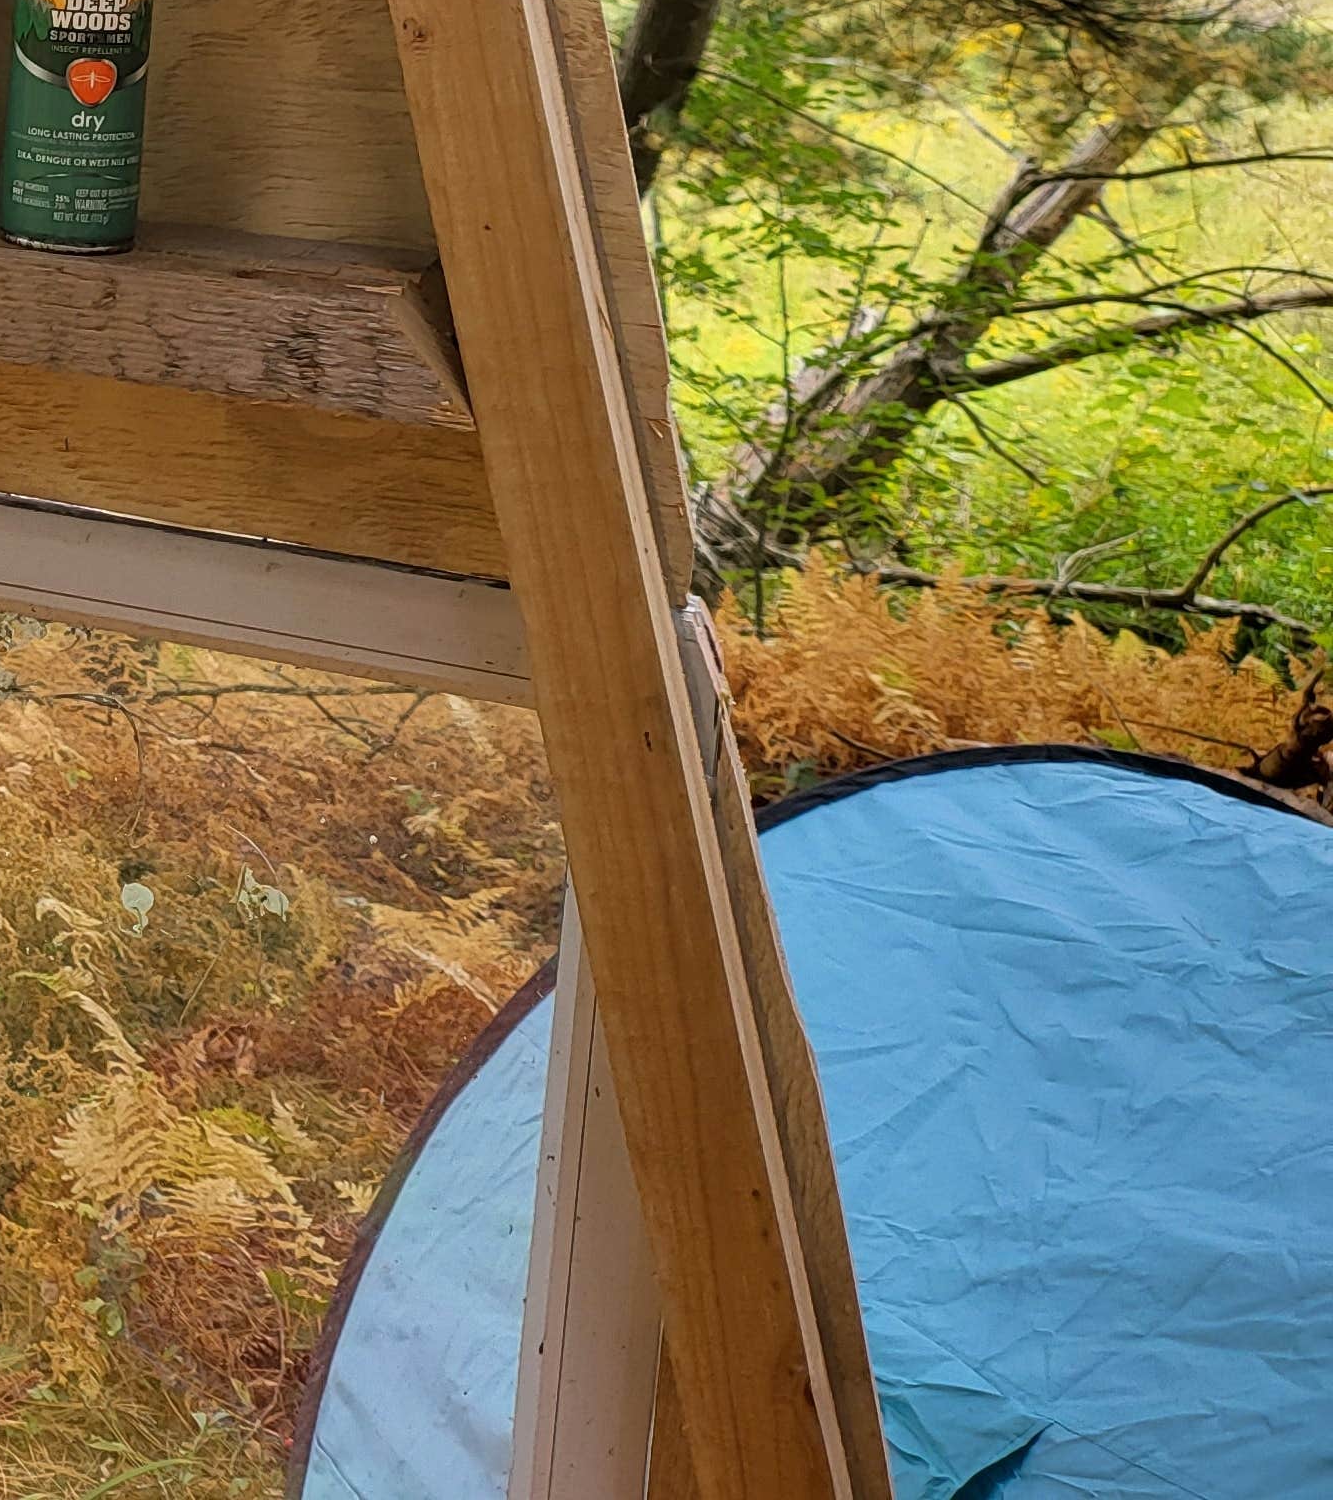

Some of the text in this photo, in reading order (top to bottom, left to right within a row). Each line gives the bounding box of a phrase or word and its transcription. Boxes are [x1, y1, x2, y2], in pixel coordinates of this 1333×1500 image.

[50, 9, 132, 31] WOODS
[49, 29, 132, 45] SPORTMEN
[52, 45, 80, 54] INSECT
[71, 111, 105, 132] dry
[28, 127, 135, 141] LONG LASTING PROTECTION
[35, 154, 72, 166] DENGUE
[73, 158, 87, 167] OR
[89, 158, 110, 167] WEST
[110, 158, 125, 166] NILE
